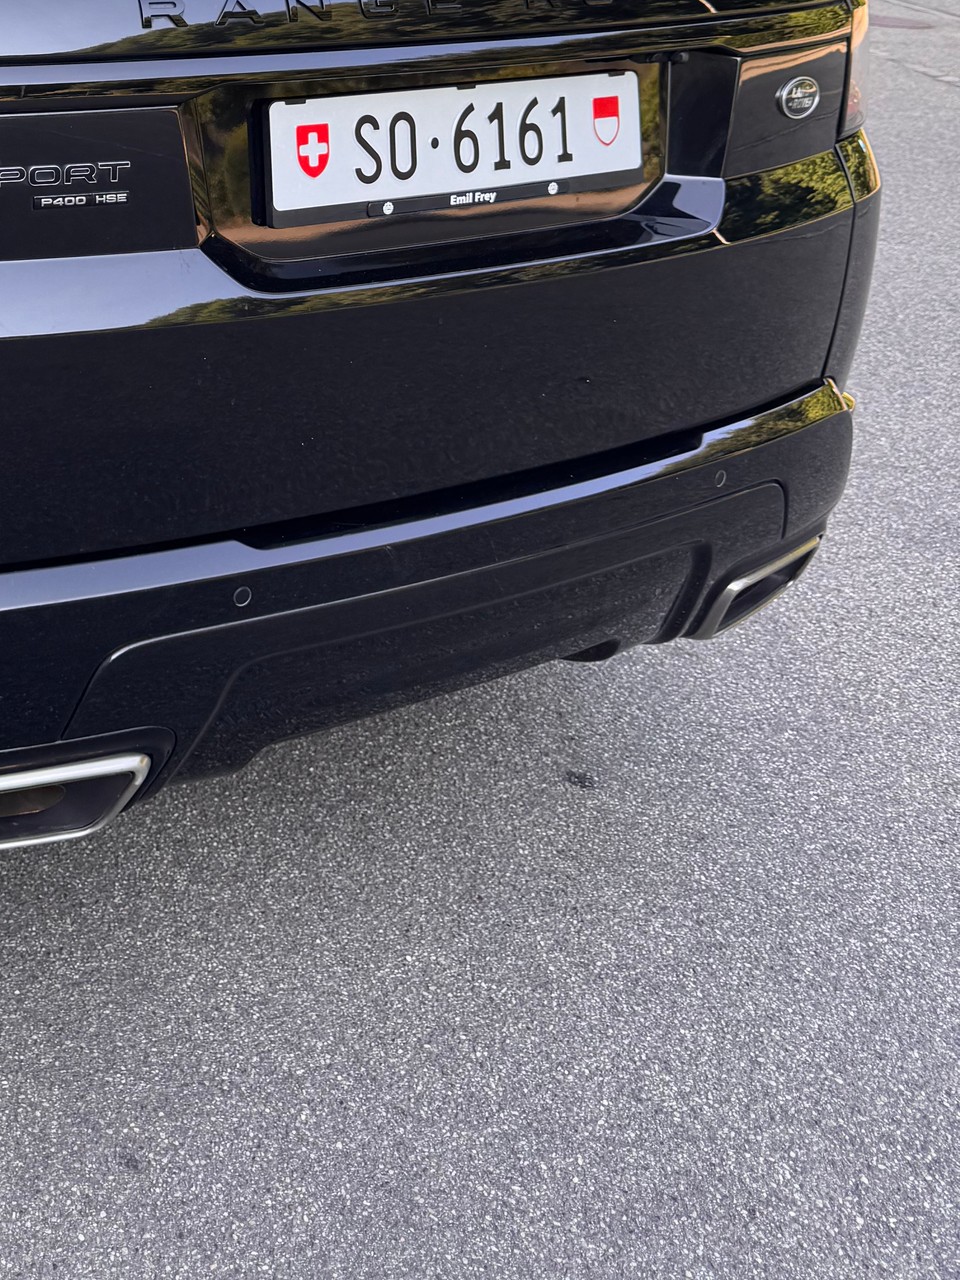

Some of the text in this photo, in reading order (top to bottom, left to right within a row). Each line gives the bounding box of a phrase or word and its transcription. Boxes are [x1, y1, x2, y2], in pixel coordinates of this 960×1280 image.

[40, 193, 128, 208] P400 HSE
[449, 191, 497, 205] Emil Frey
